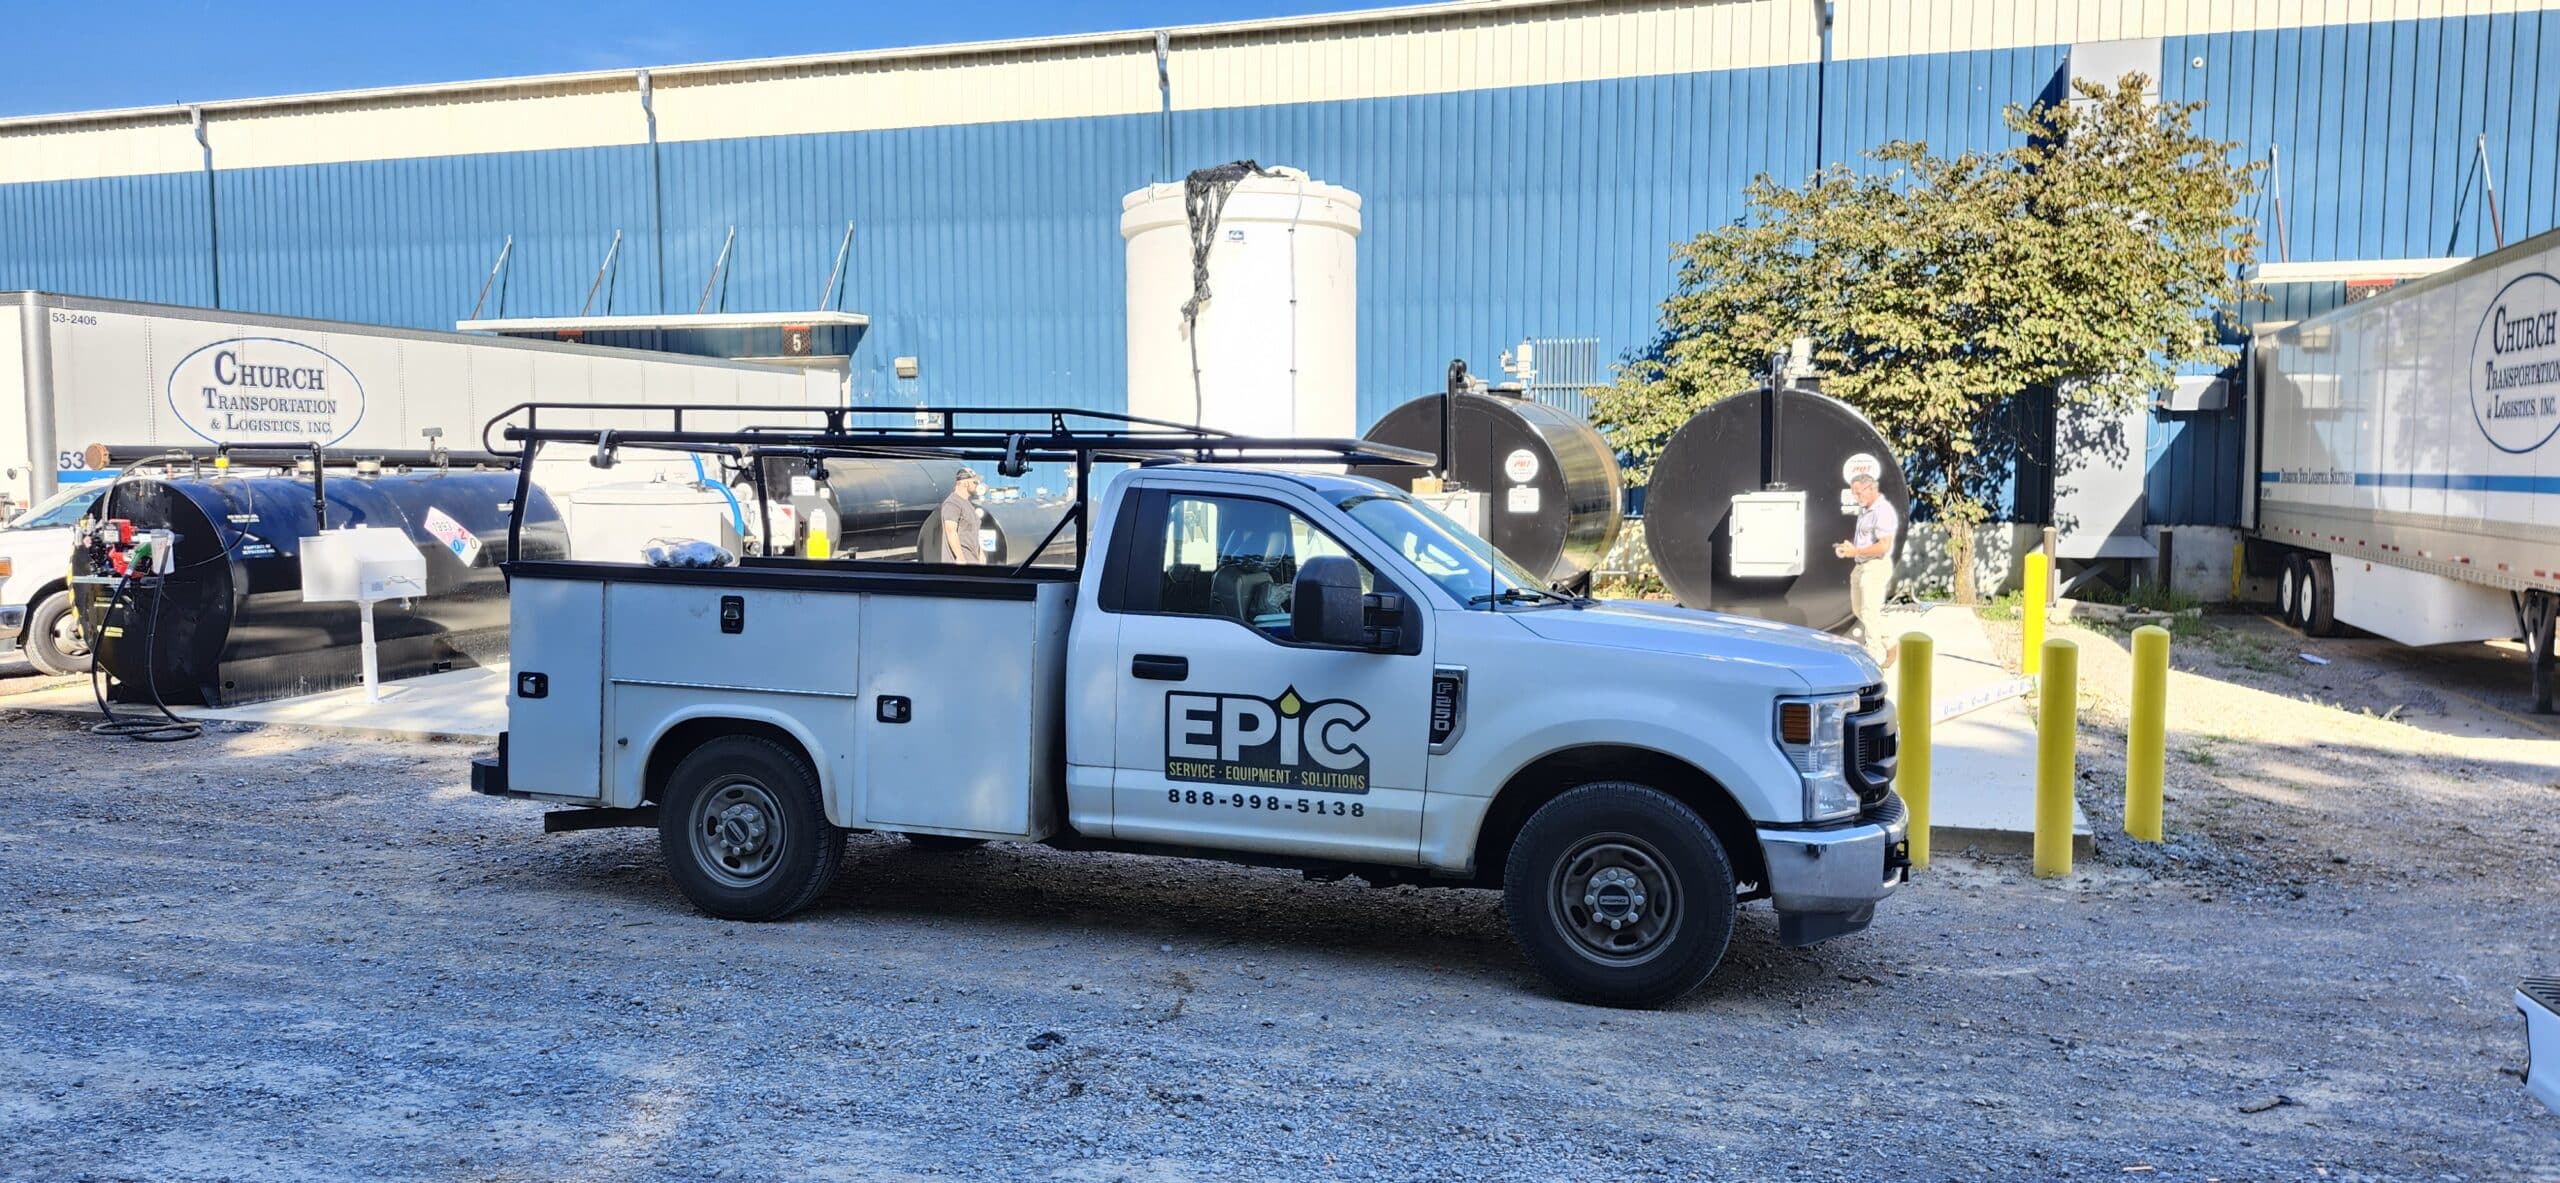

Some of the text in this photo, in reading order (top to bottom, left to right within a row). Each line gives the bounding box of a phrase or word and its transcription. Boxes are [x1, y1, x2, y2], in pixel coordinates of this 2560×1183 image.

[52, 312, 97, 326] 53-2406
[2494, 304, 2557, 355] CHURCH
[793, 333, 801, 352] 5
[214, 350, 325, 390] CHURCH
[2486, 360, 2560, 391] TRANSPORTATION
[202, 387, 337, 414] TRANSPORTATION
[210, 413, 333, 434] & LOGISTICS, INC.
[453, 539, 460, 552] 0
[458, 528, 467, 540] 2
[470, 537, 477, 550] 0
[1169, 761, 1366, 790] SERVICE EQUIPMENT SOLUTIONS
[1168, 788, 1365, 818] 888-998-5138
